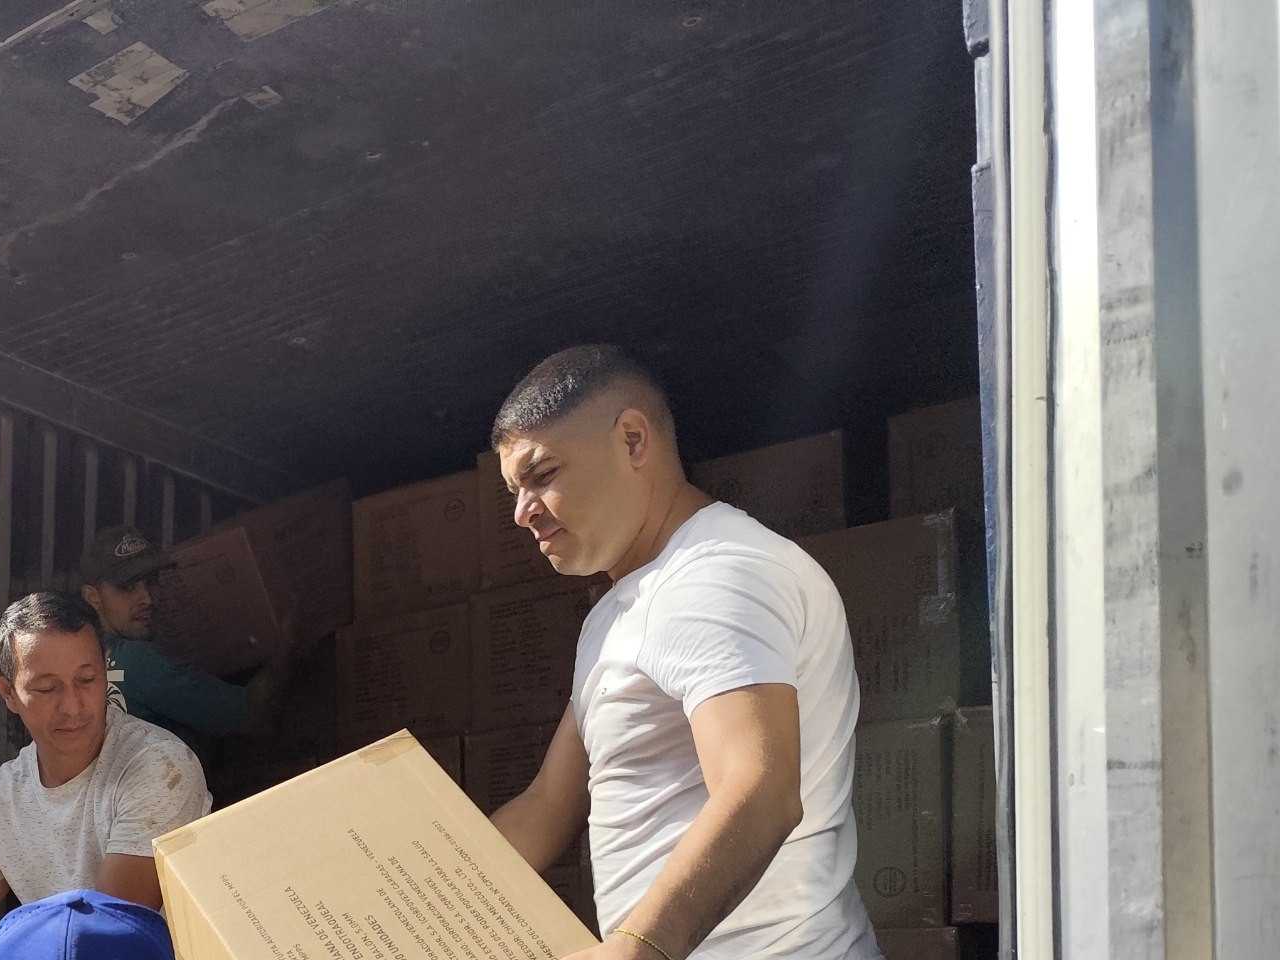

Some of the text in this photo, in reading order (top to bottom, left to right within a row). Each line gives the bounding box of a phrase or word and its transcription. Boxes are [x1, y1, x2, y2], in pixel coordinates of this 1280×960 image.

[346, 827, 376, 860] VENEZUELA
[410, 839, 431, 859] SALUD
[386, 855, 399, 865] DE
[426, 857, 438, 866] LA
[219, 873, 235, 890] MPPS
[374, 863, 400, 890] CARACAS
[394, 863, 428, 901] VENEZOLANA
[433, 865, 451, 882] PARA
[230, 889, 240, 897] EL
[375, 887, 387, 896] DE
[446, 881, 473, 908] POPULAR
[236, 897, 249, 909] POR
[282, 885, 320, 929] VENEZUELA
[473, 890, 499, 915] MEHECO
[341, 911, 363, 934] 5.0MM
[382, 895, 417, 934] VENEZOLANA
[423, 900, 463, 943] CORPORACIÓN
[469, 908, 491, 929] PODER
[494, 914, 515, 935] CHINA
[244, 908, 274, 945] AUTORIZADA
[312, 899, 363, 960] ENDOTRAQUEAL
[314, 928, 329, 940] DE
[363, 913, 400, 953] UNIDADES
[486, 928, 501, 941] DEL
[523, 926, 539, 939] DEL
[292, 942, 310, 960] MPPS
